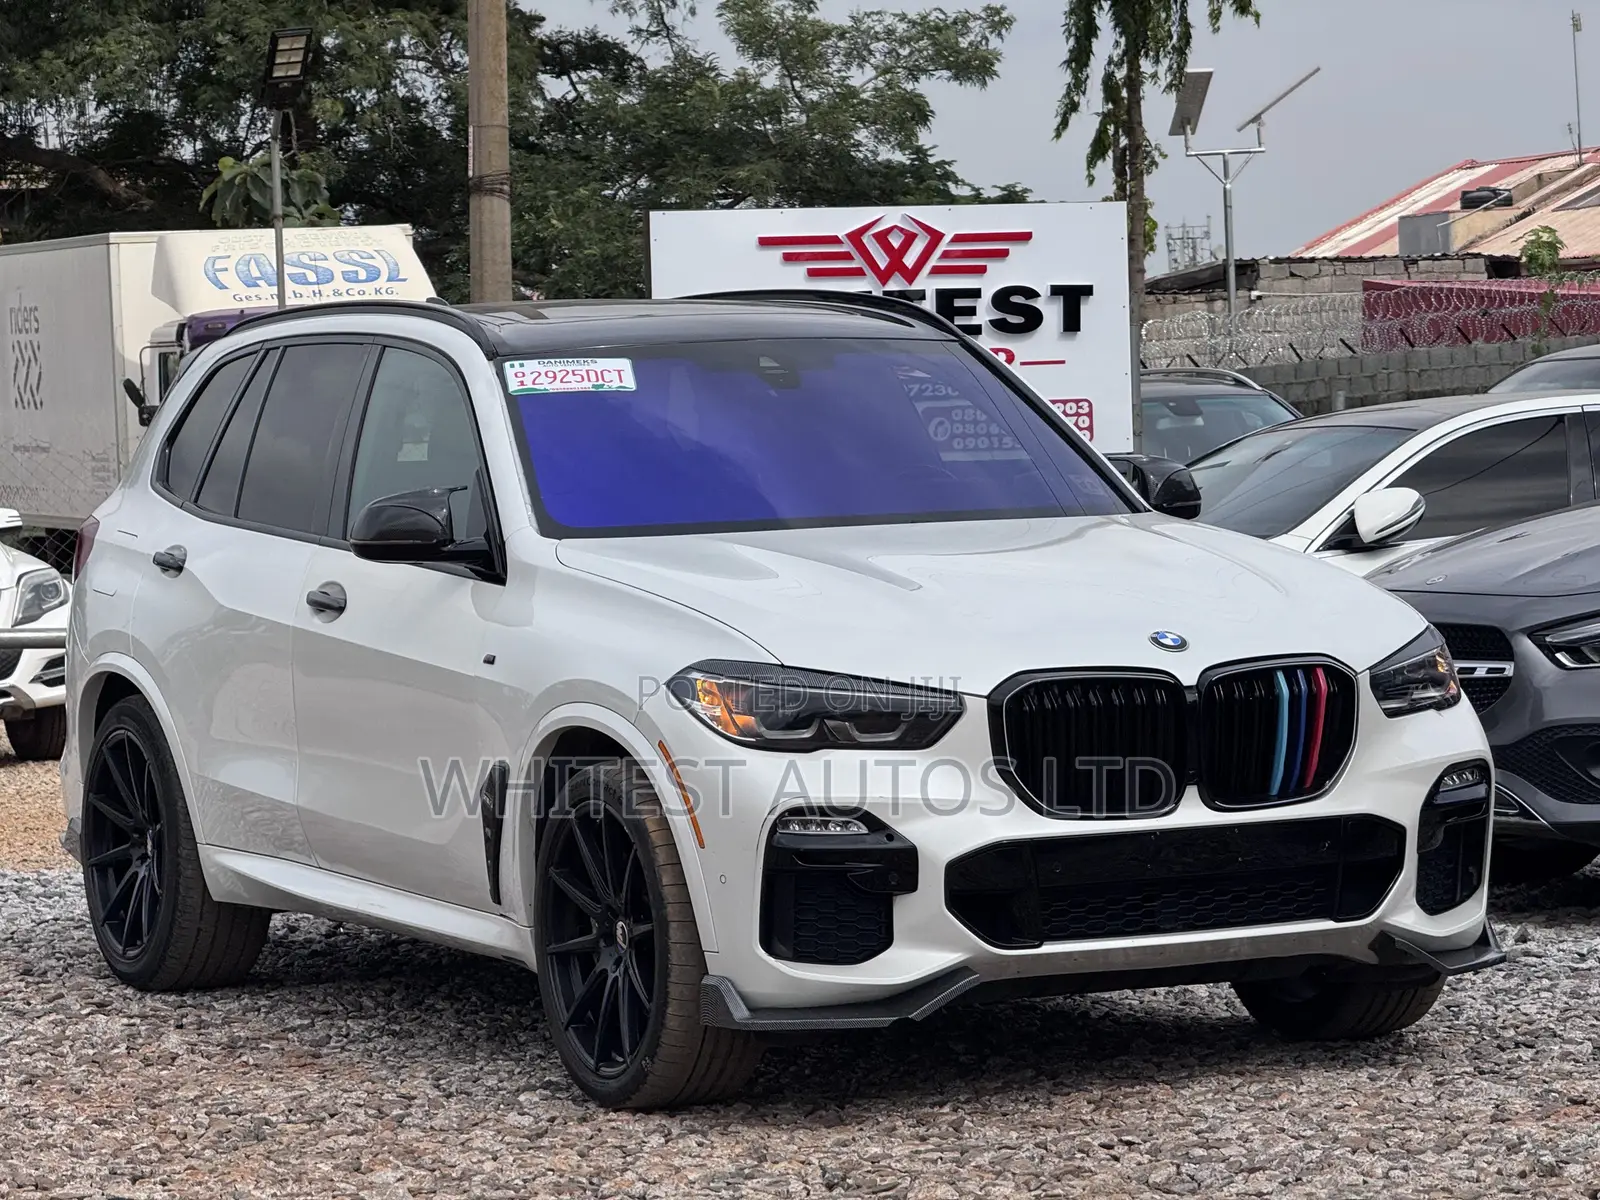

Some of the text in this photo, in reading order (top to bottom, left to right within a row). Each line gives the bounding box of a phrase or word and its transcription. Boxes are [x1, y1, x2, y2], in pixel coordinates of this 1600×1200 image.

[203, 249, 409, 290] FASSL
[856, 284, 1094, 335] EST
[529, 368, 625, 386] 2925DCT
